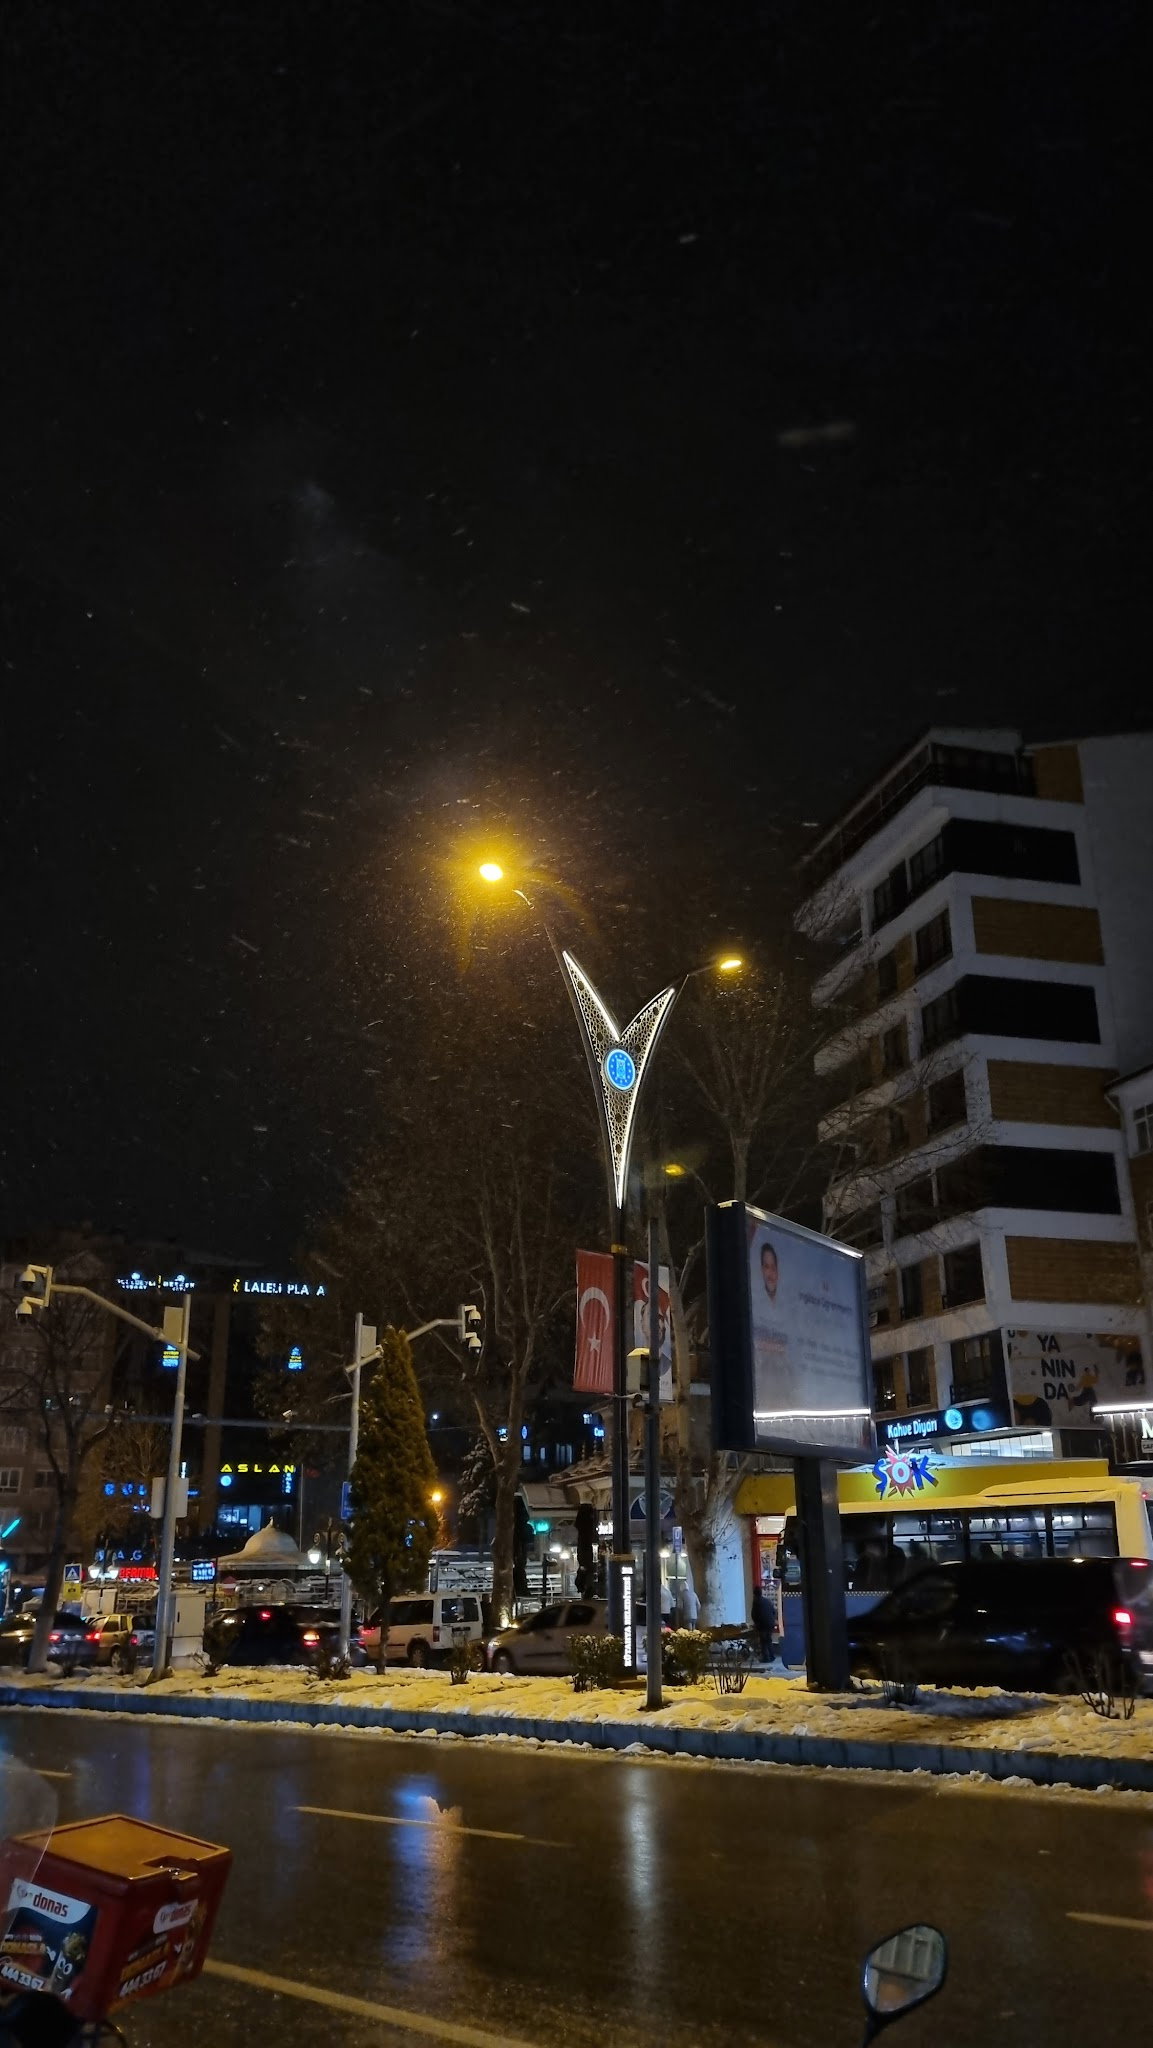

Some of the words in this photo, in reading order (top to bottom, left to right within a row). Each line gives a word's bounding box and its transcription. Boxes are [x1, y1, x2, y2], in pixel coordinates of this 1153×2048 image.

[1037, 1334, 1061, 1353] YA
[1041, 1359, 1076, 1378] NIN
[887, 1423, 912, 1439] Kahve
[220, 1463, 295, 1473] ASLAN
[33, 1893, 68, 1917] donas
